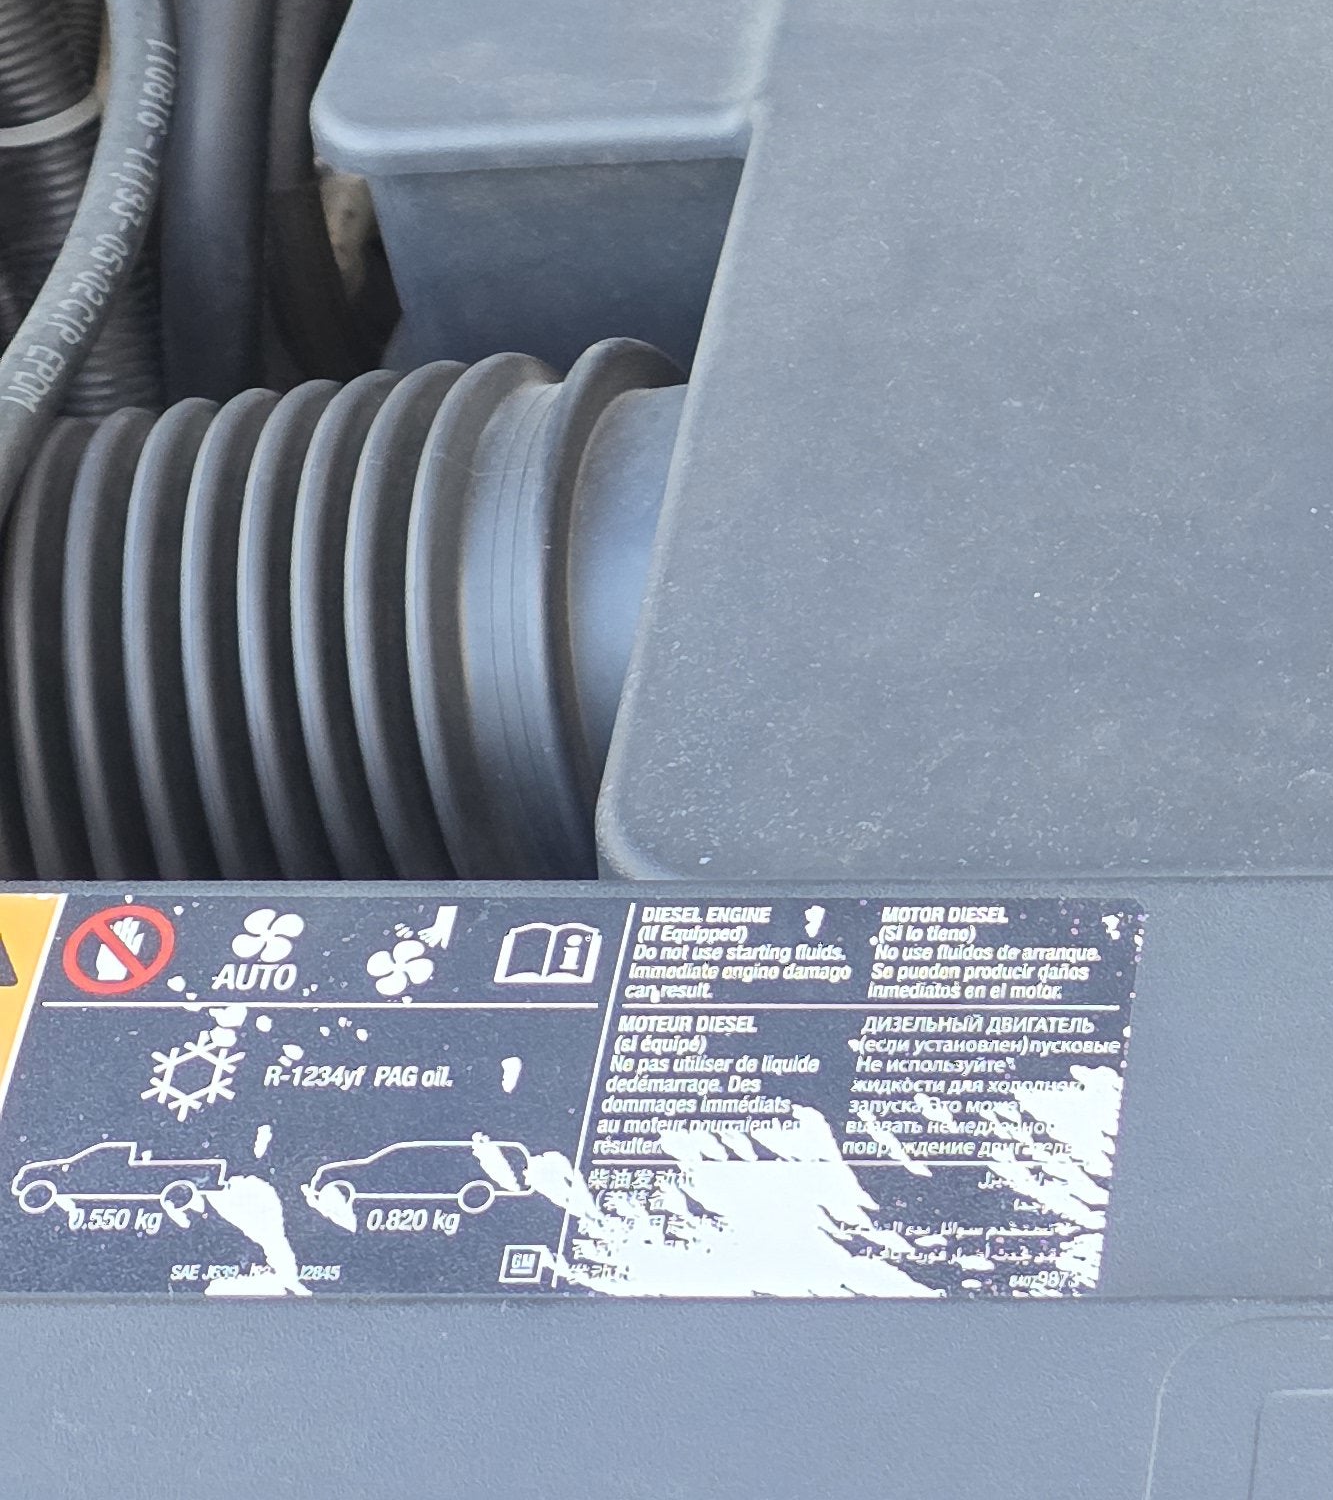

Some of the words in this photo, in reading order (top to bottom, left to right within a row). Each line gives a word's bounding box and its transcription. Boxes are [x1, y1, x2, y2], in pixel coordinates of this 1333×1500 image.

[641, 906, 703, 923] DIESEL
[706, 906, 772, 923] ENGINE
[881, 906, 944, 923] MOTOR
[948, 906, 1009, 923] DIESEL
[660, 925, 748, 944] Equipped)
[632, 944, 657, 960] Do
[660, 945, 688, 960] not
[692, 947, 723, 961] use
[726, 944, 792, 963] starting
[794, 943, 846, 961] fluids.
[874, 944, 899, 960] No
[902, 947, 932, 960] use
[997, 944, 1020, 960] de
[212, 963, 297, 991] AUTO
[628, 962, 719, 979] Immediate
[721, 964, 780, 983] engine
[782, 963, 852, 983] damage
[871, 963, 893, 980] Se
[896, 964, 960, 982] pueden
[963, 963, 1034, 982] producir
[1037, 963, 1090, 980] daños
[624, 984, 658, 999] can
[660, 982, 713, 998] result.
[965, 984, 986, 998] en
[989, 983, 1007, 998] el
[618, 1015, 693, 1032] MOTEUR
[696, 1015, 758, 1033] DIESEL
[861, 1014, 984, 1035] ДИЗЕЛЬНЫЙ
[985, 1016, 1095, 1036] ДВИГАТЕЛЬ
[640, 1034, 707, 1055] équipé)
[609, 1055, 634, 1072] Ne
[636, 1058, 669, 1076] pas
[672, 1055, 734, 1073] utiliser
[735, 1055, 758, 1073] de
[761, 1054, 820, 1076] liquide
[855, 1056, 882, 1073] Не
[264, 1065, 367, 1091] R-1234yf
[373, 1065, 418, 1088] PAG
[421, 1065, 454, 1088] oil.
[727, 1075, 762, 1093] Des
[602, 1096, 698, 1116] dommages
[965, 1100, 1022, 1115] може
[597, 1119, 621, 1133] au
[68, 1208, 130, 1231] 0.550
[133, 1207, 163, 1235] kg
[366, 1208, 427, 1232] 0.820
[432, 1208, 461, 1236] kg
[170, 1264, 200, 1281] SAE
